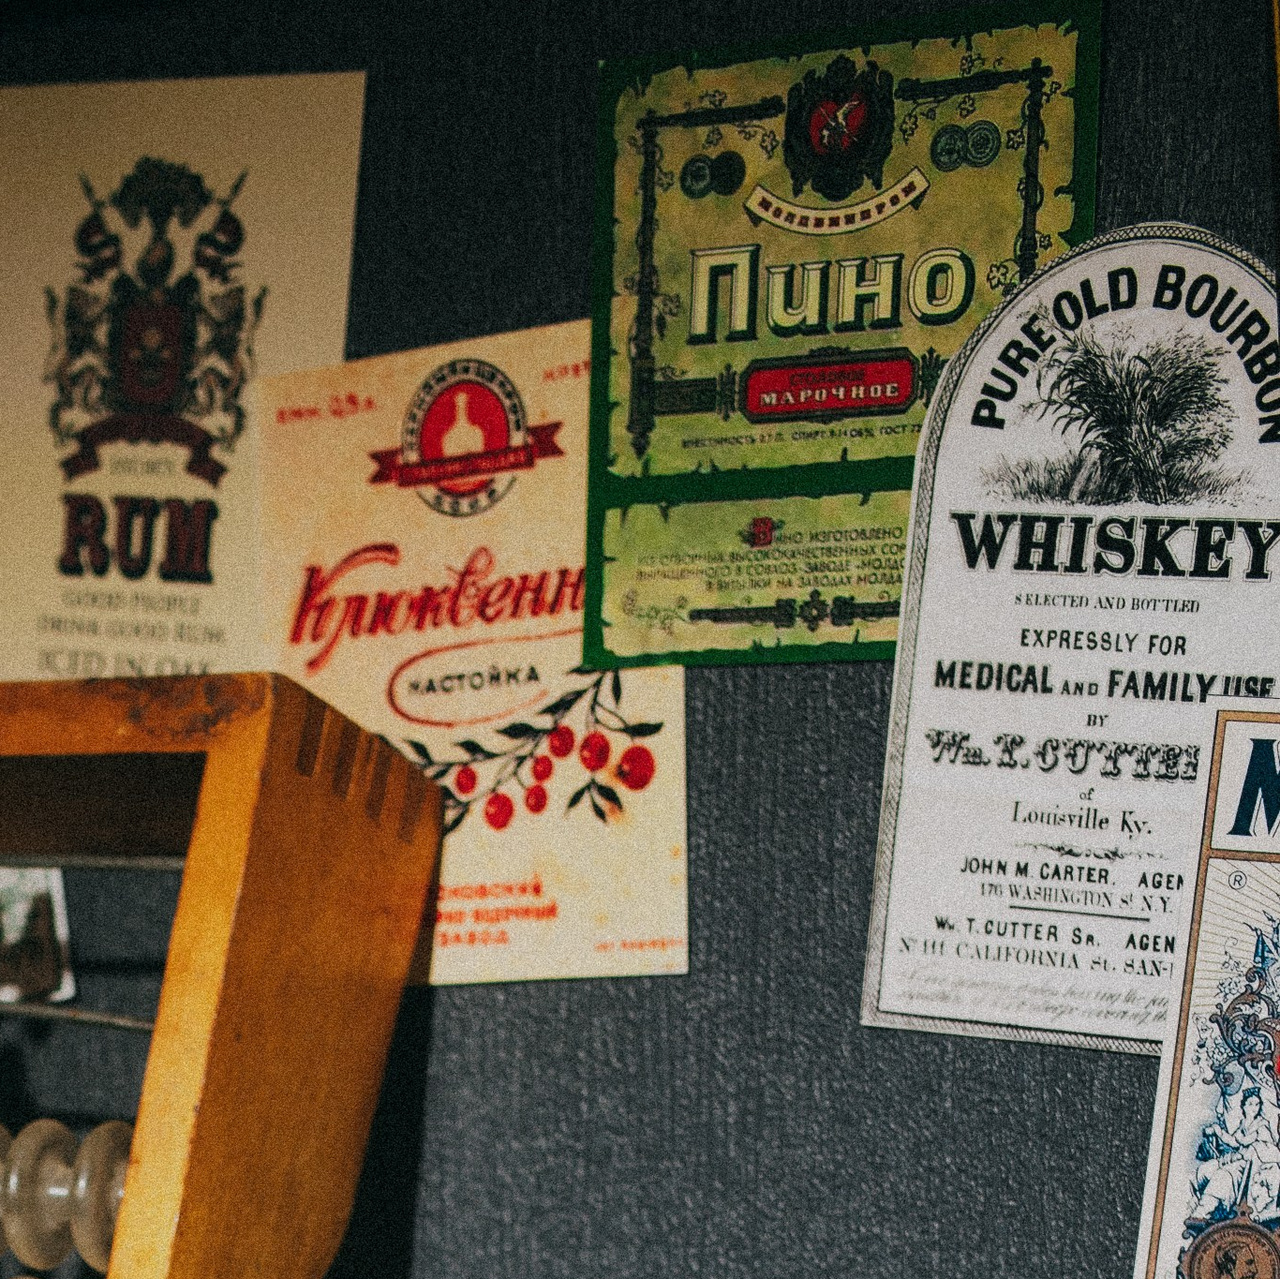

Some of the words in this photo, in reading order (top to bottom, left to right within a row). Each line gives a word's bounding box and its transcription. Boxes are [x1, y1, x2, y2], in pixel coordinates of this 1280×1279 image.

[971, 313, 1057, 430] PURE
[1052, 267, 1138, 332] OLD
[759, 382, 899, 406] МАРОЧНОЕ
[879, 423, 907, 436] ГОСТ
[56, 494, 220, 584] RUM
[950, 511, 1280, 580] WHISKEY
[1015, 592, 1089, 610] SELECTED
[1094, 595, 1126, 611] AND
[1131, 597, 1200, 614] BOTTLED
[1020, 627, 1139, 653] EXPRESSLY
[1148, 633, 1187, 656] FOR
[408, 664, 541, 697] НАСТОЙКА
[934, 659, 1053, 694] MEDICAL
[1061, 680, 1099, 697] AND
[1108, 669, 1218, 703] FAMILY
[1222, 675, 1276, 698] USE
[1086, 713, 1109, 728] BY
[1079, 787, 1095, 801] of
[1012, 801, 1110, 831] Louisville
[1121, 810, 1152, 839] Ky.
[961, 857, 1007, 876] JOHN
[1008, 883, 1113, 909] WASHINGTON
[984, 920, 1058, 943] CUTTER
[1125, 934, 1175, 954] AGEN
[956, 941, 1080, 970] CALIFORNIA
[1123, 958, 1175, 979] SAN-
